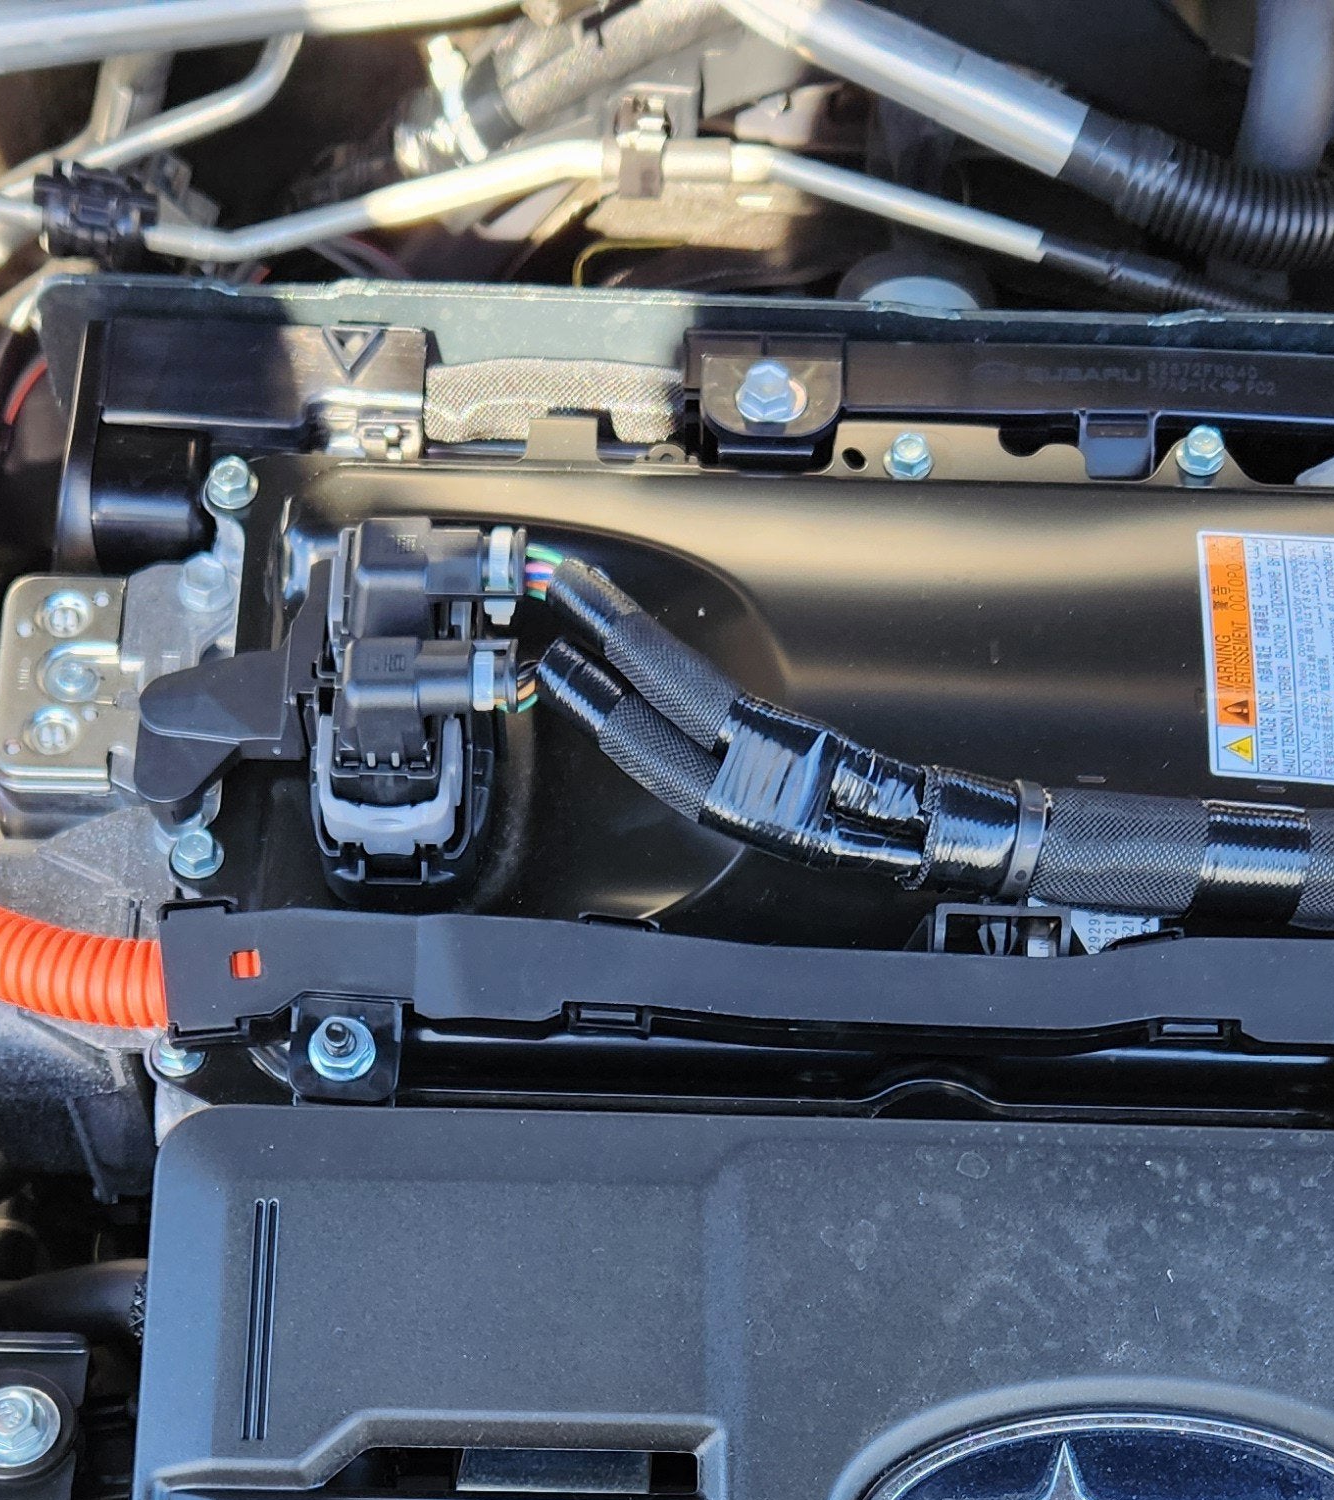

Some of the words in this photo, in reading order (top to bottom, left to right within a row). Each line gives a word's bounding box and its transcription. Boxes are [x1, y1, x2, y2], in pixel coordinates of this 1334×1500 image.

[1024, 365, 1141, 384] SUBARU
[1216, 635, 1234, 693] WARNING
[1231, 621, 1251, 693] AVERTISSEMENT
[1259, 716, 1278, 750] VOLTAGE
[1300, 731, 1312, 754] NOT
[1260, 754, 1279, 773] HIGH
[1301, 759, 1314, 775] DO
